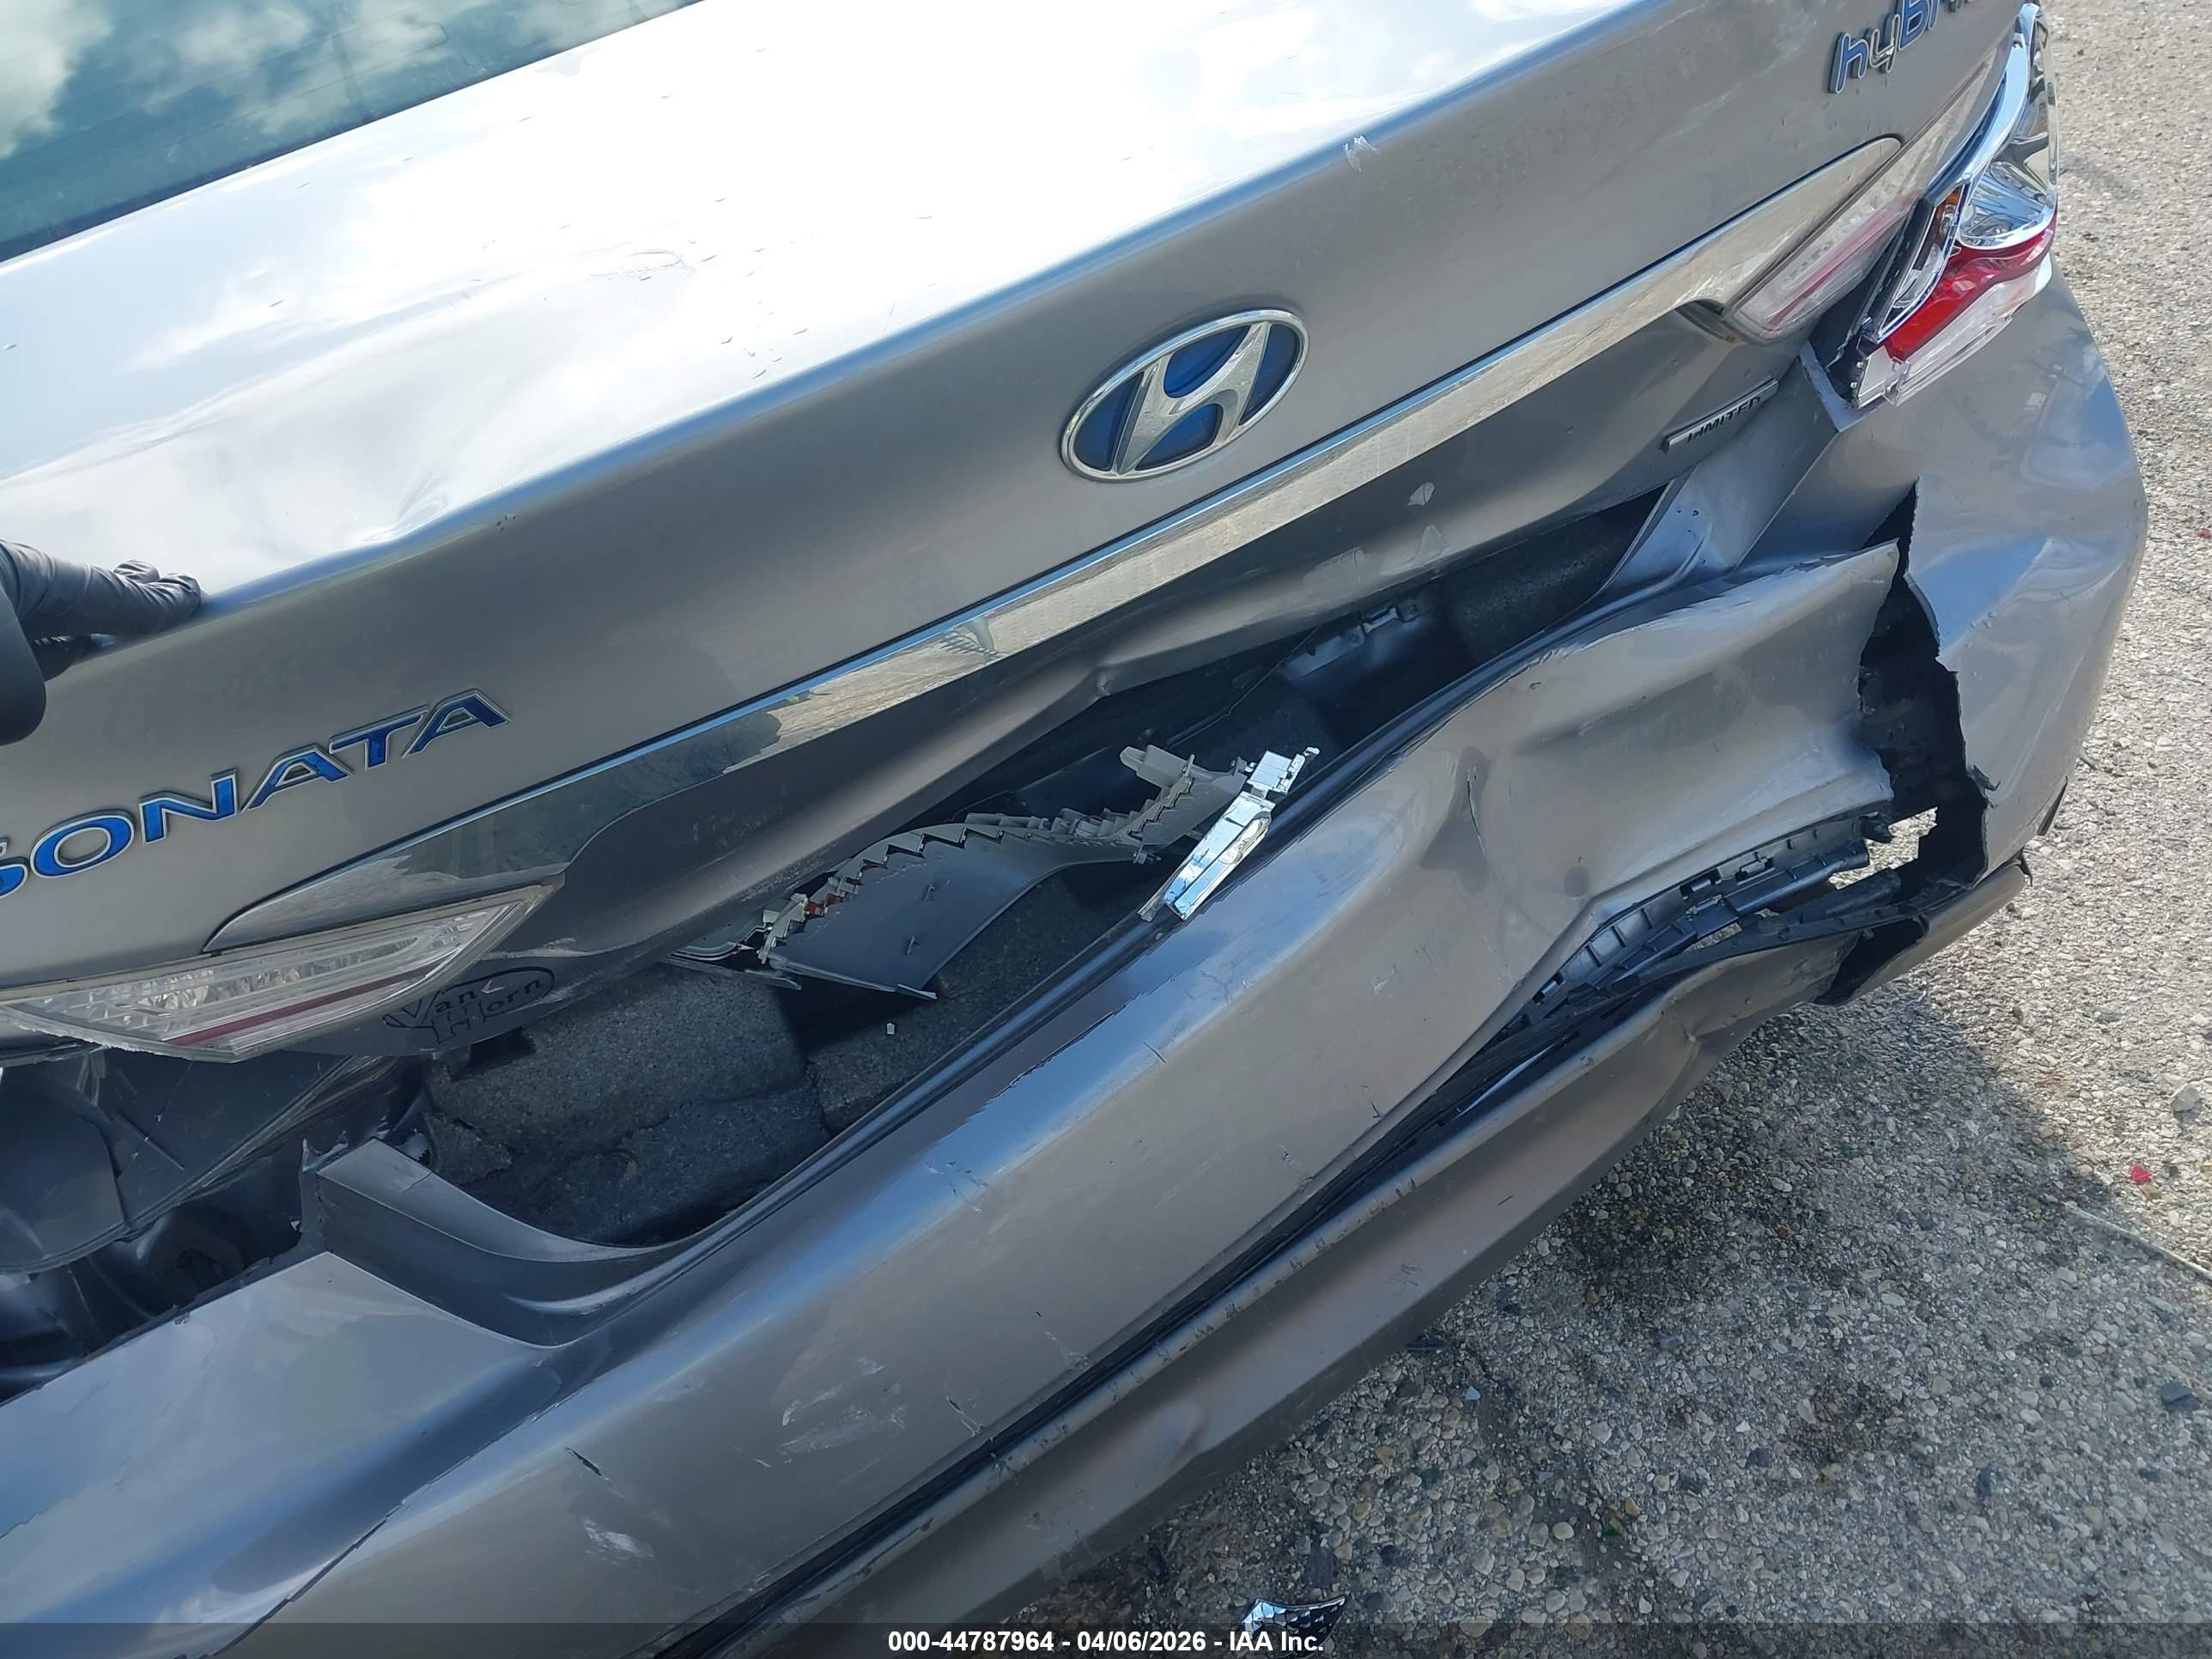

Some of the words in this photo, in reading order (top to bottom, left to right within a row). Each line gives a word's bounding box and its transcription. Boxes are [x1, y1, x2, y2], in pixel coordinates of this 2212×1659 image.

[1828, 0, 1974, 94] hyb
[384, 989, 477, 1028] Van
[432, 979, 540, 1044] Horn
